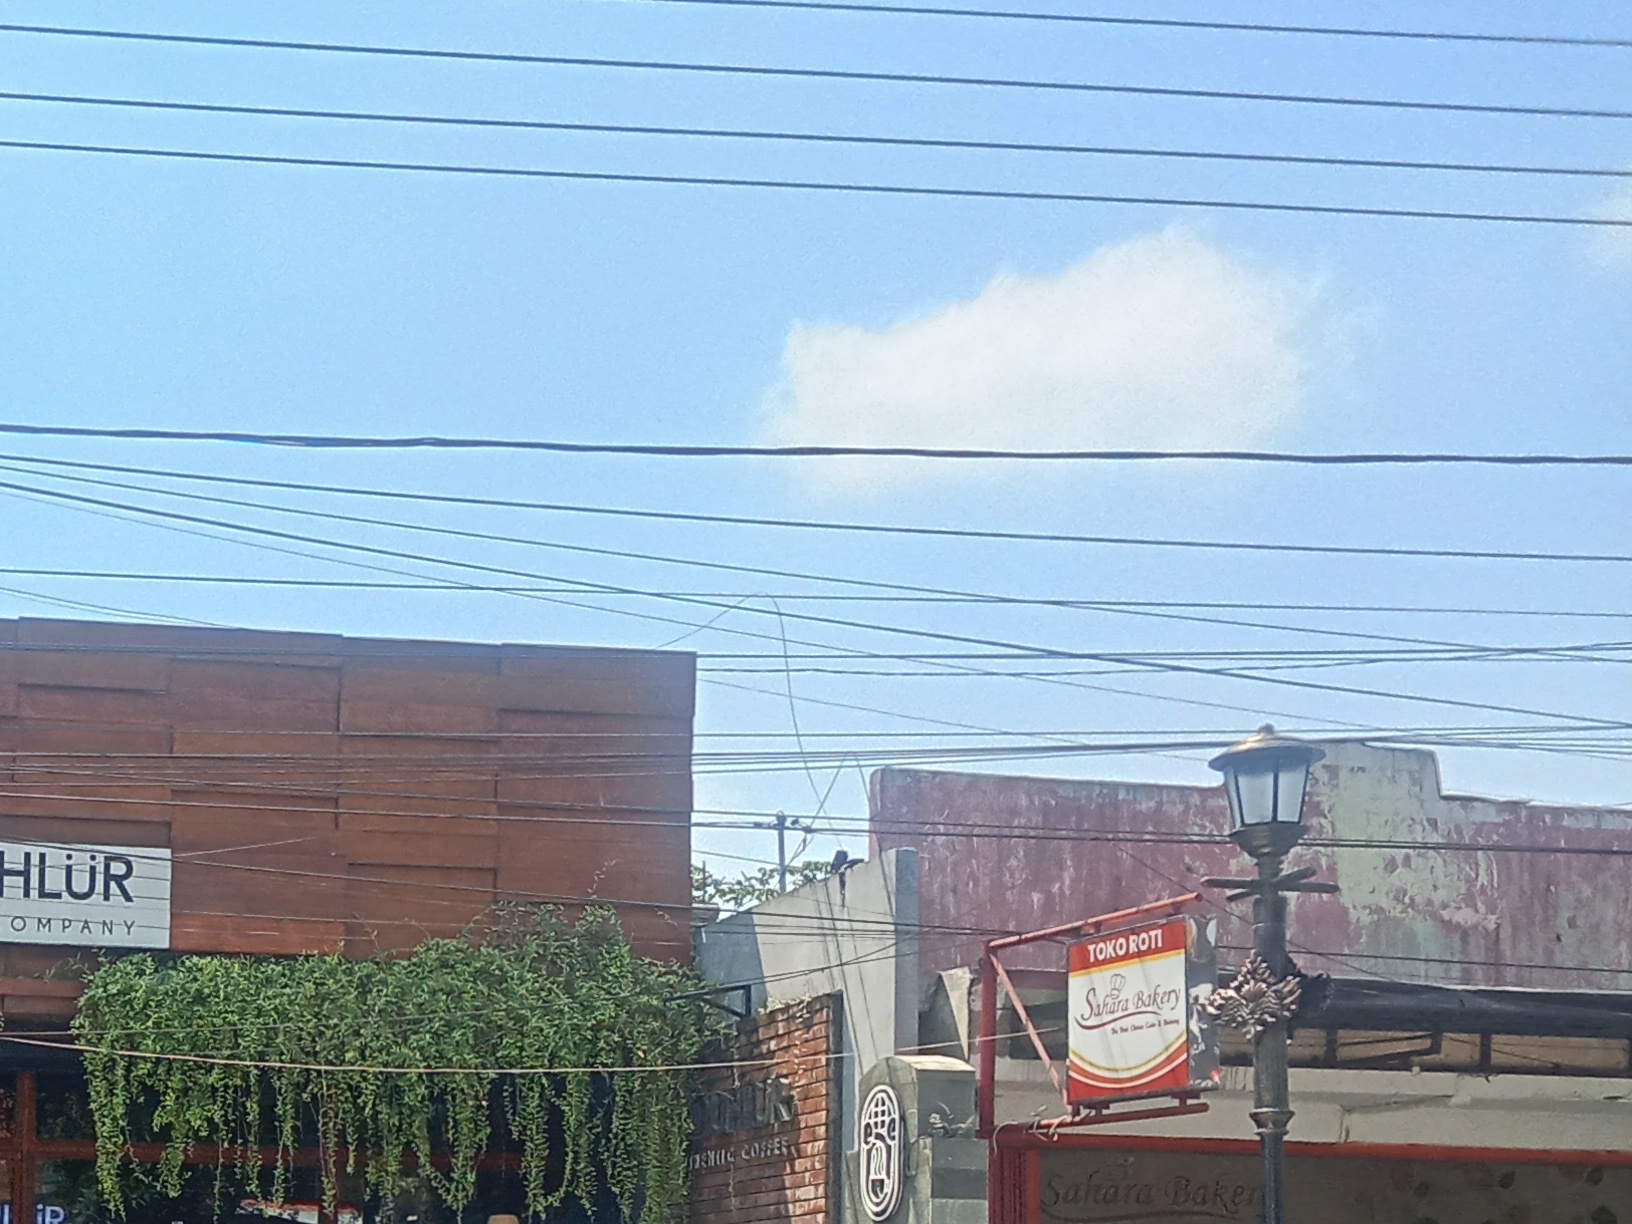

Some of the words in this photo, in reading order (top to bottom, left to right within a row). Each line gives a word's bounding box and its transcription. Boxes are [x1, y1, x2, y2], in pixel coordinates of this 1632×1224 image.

[1087, 937, 1127, 963] TOKO
[1128, 929, 1163, 954] ROTI
[1081, 986, 1130, 1021] Sahara
[1132, 984, 1181, 1012] Bakery
[1042, 1169, 1153, 1208] Sahara
[1163, 1173, 1266, 1214] Baker
